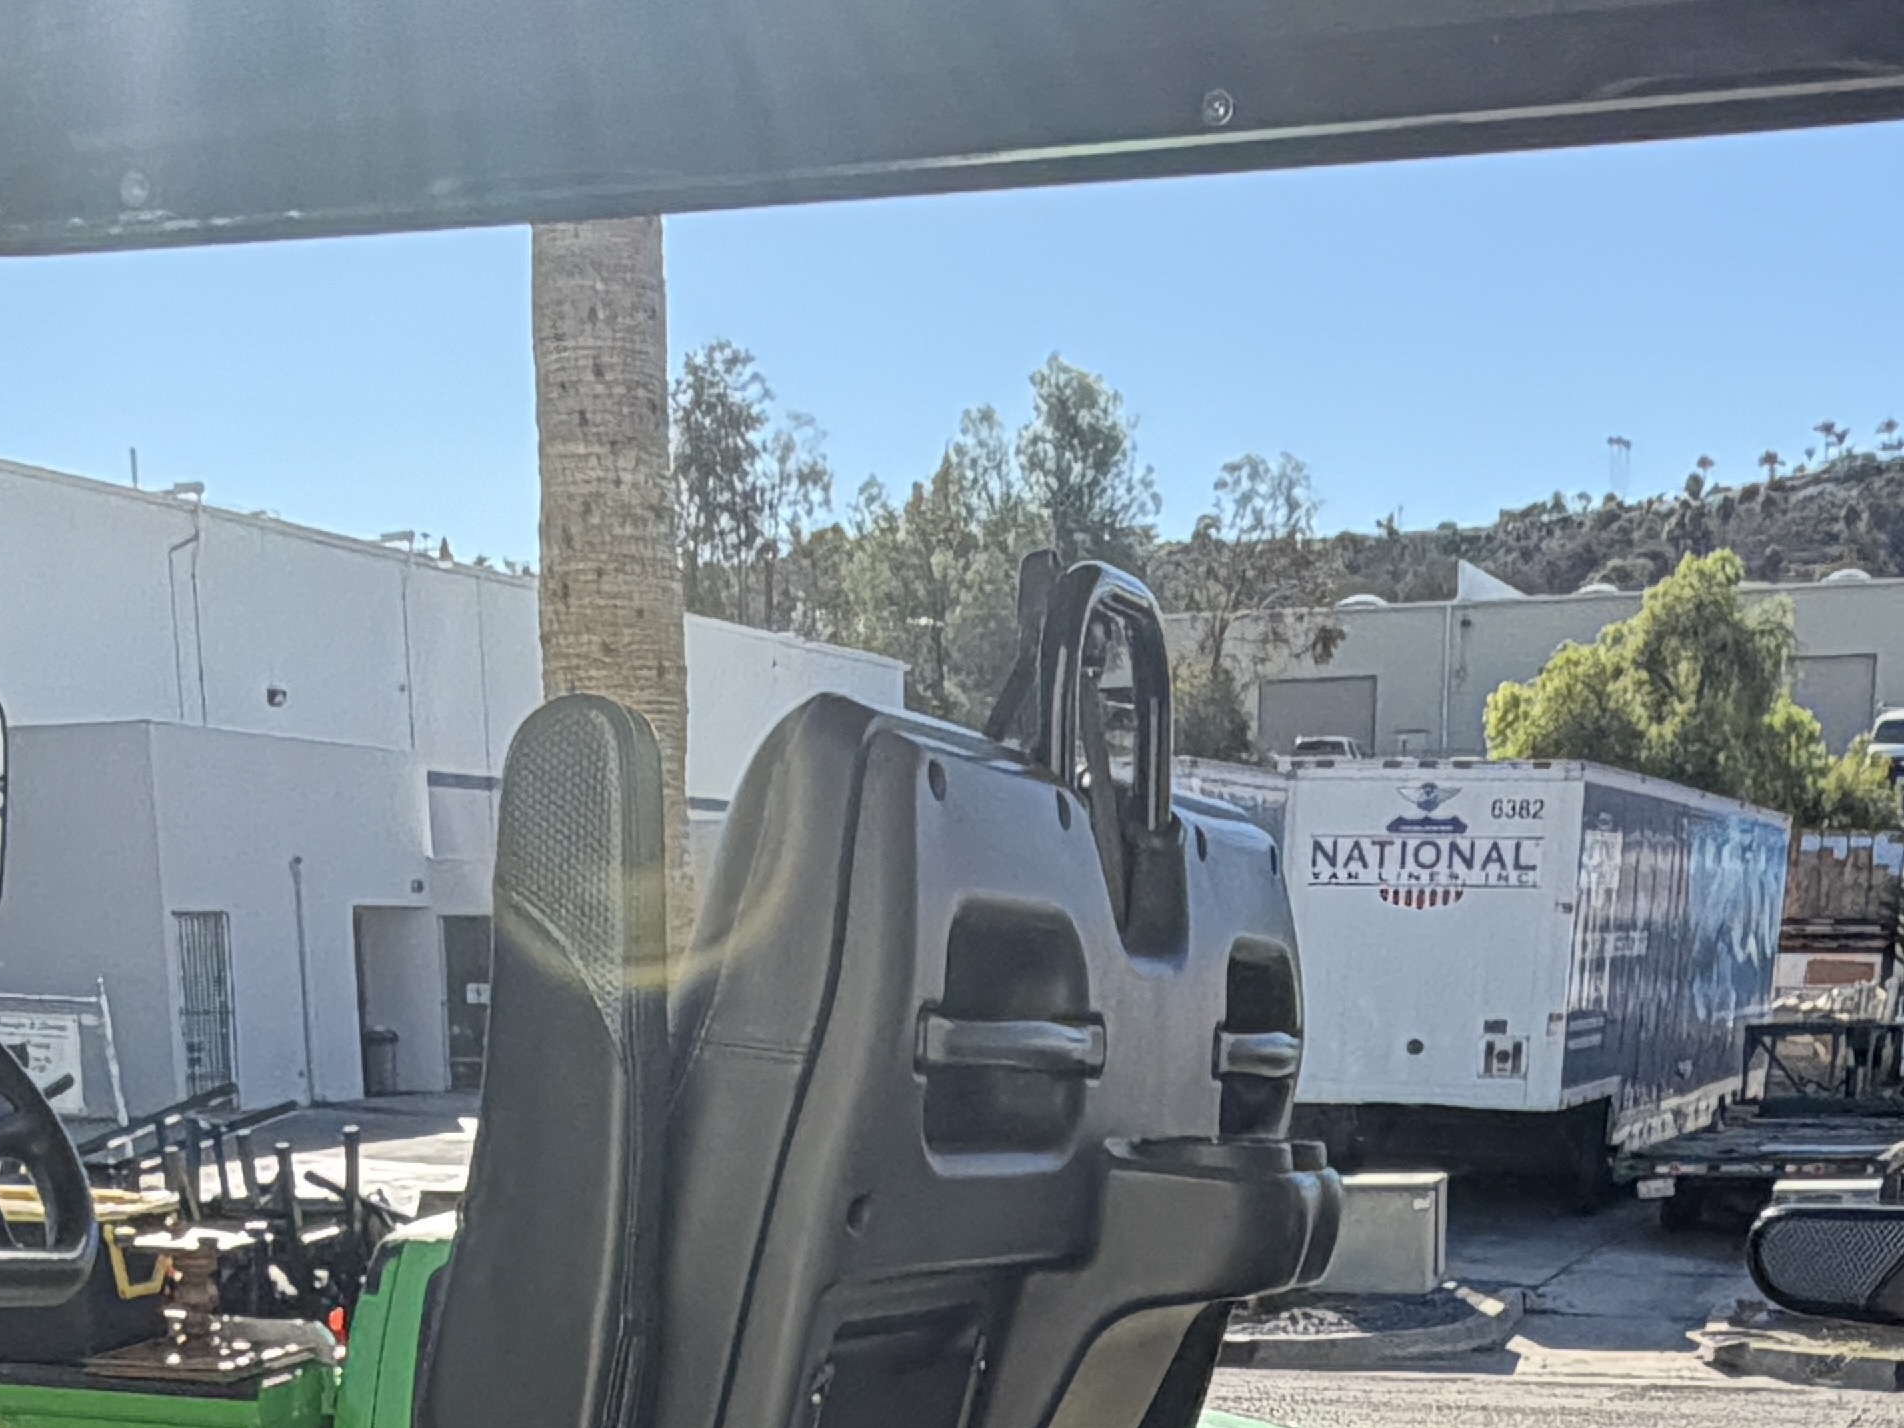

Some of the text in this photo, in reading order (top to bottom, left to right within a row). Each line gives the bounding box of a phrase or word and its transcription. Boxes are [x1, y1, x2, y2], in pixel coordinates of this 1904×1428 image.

[1491, 799, 1544, 819] 6382
[1311, 840, 1537, 871] NATIONAL
[1312, 871, 1359, 880] VAN
